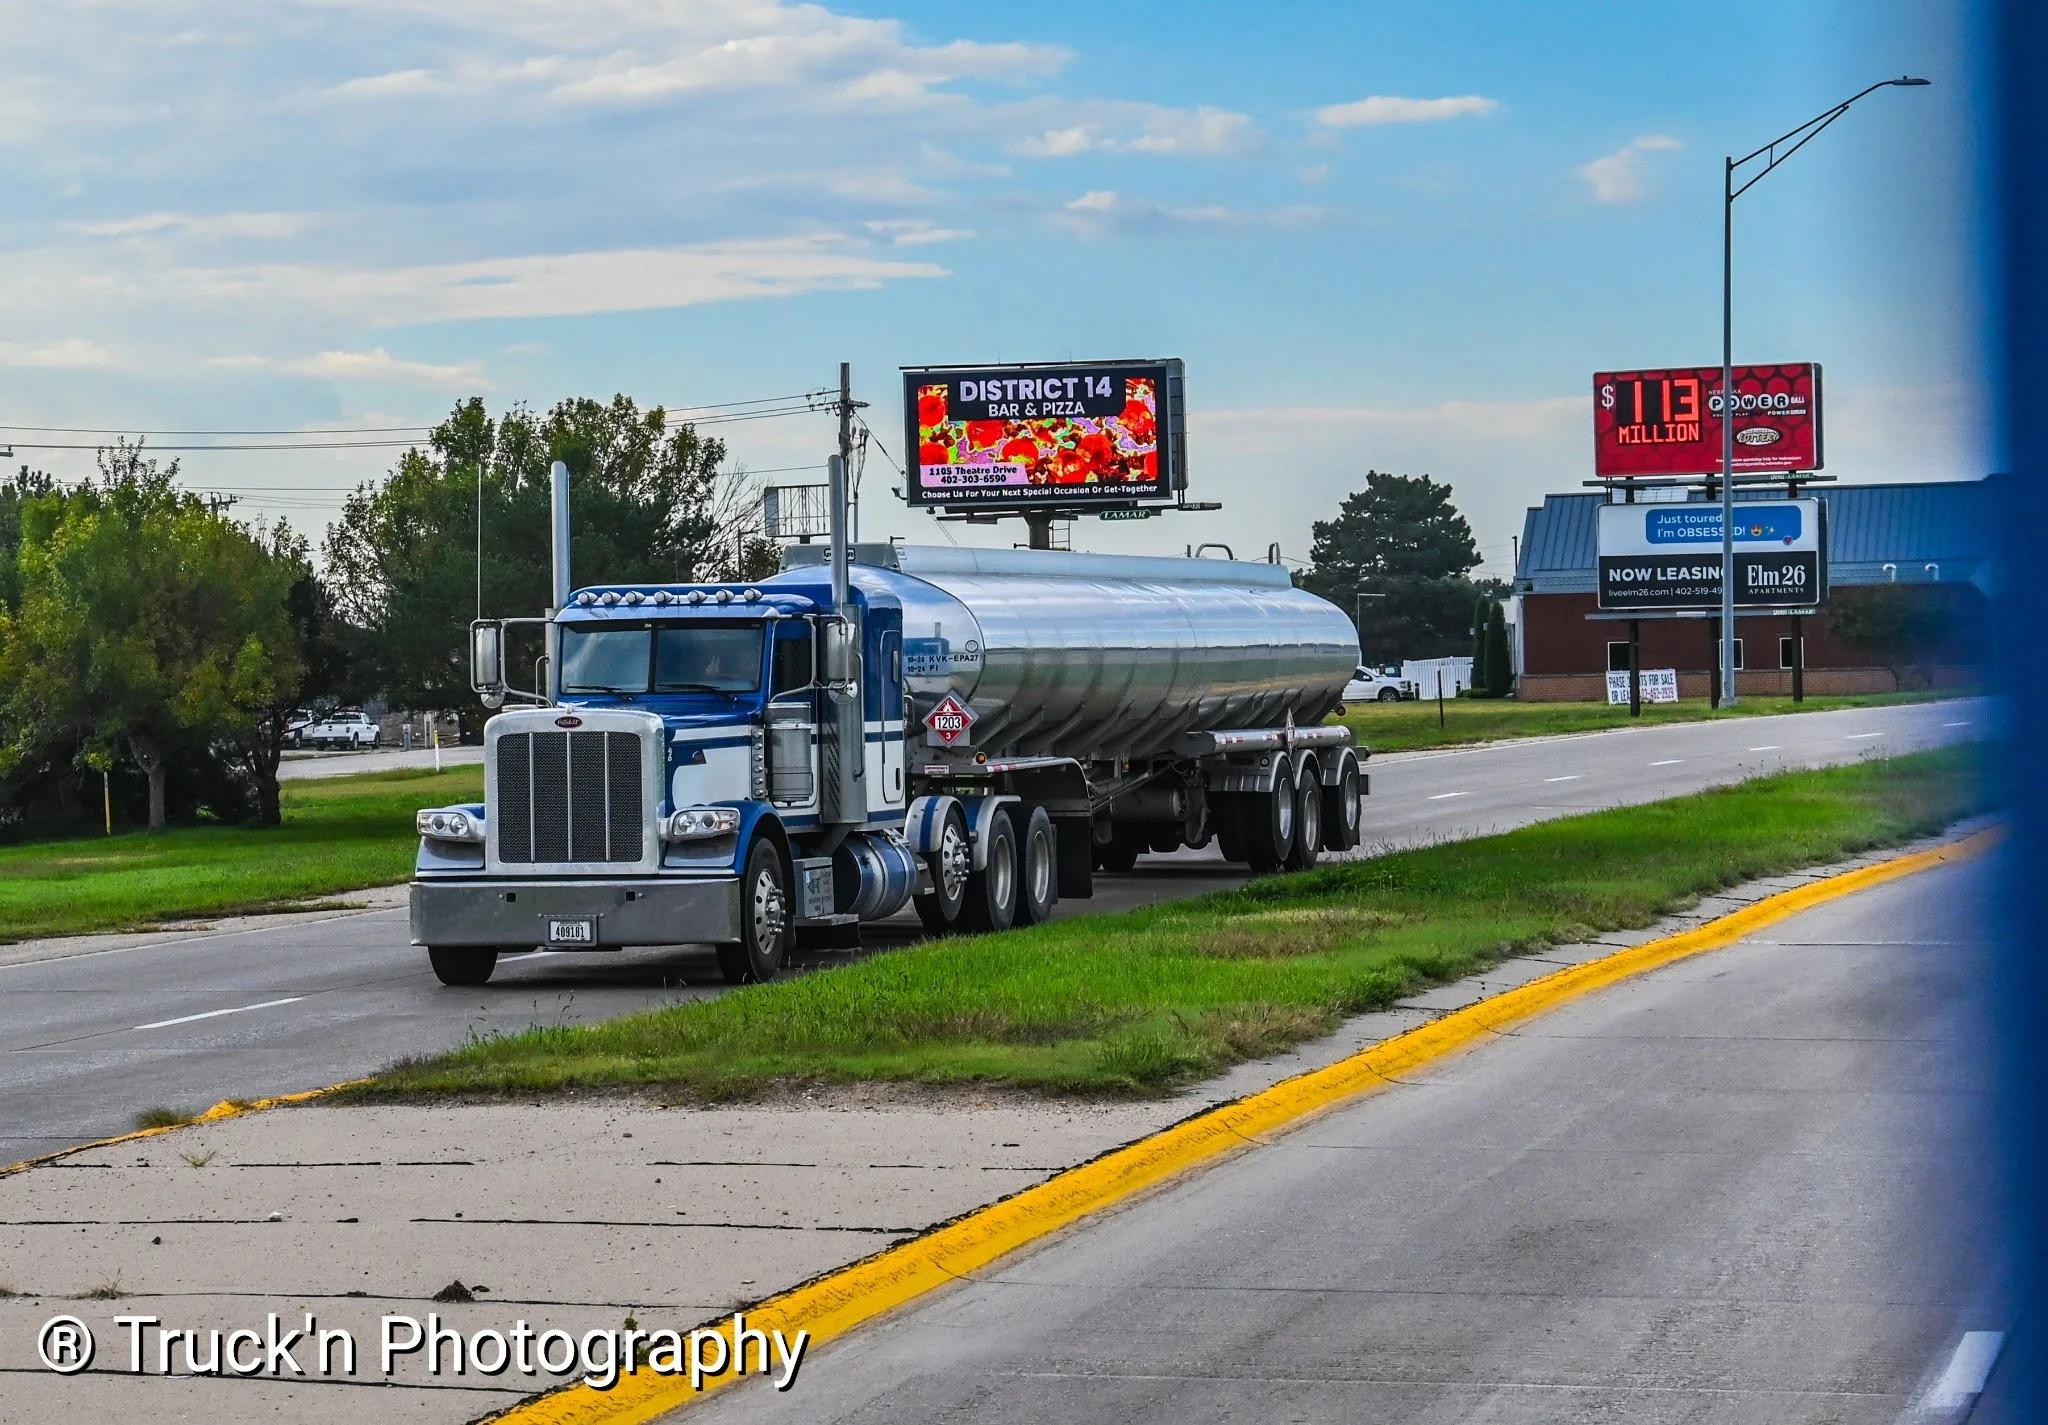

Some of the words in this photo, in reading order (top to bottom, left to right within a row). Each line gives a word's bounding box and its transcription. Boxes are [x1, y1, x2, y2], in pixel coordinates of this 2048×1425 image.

[960, 378, 1078, 401] DISTRICT
[1085, 376, 1112, 398] 14
[1602, 384, 1614, 410] $
[1635, 379, 1699, 422] 113
[988, 403, 1019, 417] BAR
[1026, 403, 1038, 416] &
[1043, 402, 1085, 415] PIZZA
[1619, 423, 1698, 444] MILLION
[1737, 431, 1779, 443] LOTTERY
[930, 467, 952, 475] 1105
[941, 474, 1006, 484] 402-303-6590
[981, 489, 1000, 497] Your
[1023, 488, 1051, 497] Special
[1054, 486, 1089, 494] Occasion
[1104, 485, 1157, 494] Get-Together
[1104, 511, 1145, 519] LAMAR
[1658, 515, 1681, 524] Just
[1685, 514, 1723, 523] toured
[1658, 529, 1674, 537] I'm
[1677, 526, 1746, 537] OBSESSD!
[1609, 568, 1652, 581] NOW
[1657, 567, 1724, 580] LEASIN
[1748, 565, 1779, 586] Elm
[1782, 565, 1806, 585] 26
[1609, 588, 1669, 597] liveelm26.com
[1675, 587, 1723, 595] 402-519-49
[1749, 587, 1804, 595] APARTMENTS
[1609, 677, 1625, 688] PHASE
[1649, 674, 1659, 685] FOR
[1661, 673, 1674, 685] SALE
[1611, 690, 1619, 702] OR
[1621, 690, 1630, 701] LEA
[937, 717, 961, 729] 1203
[555, 926, 585, 938] 409181
